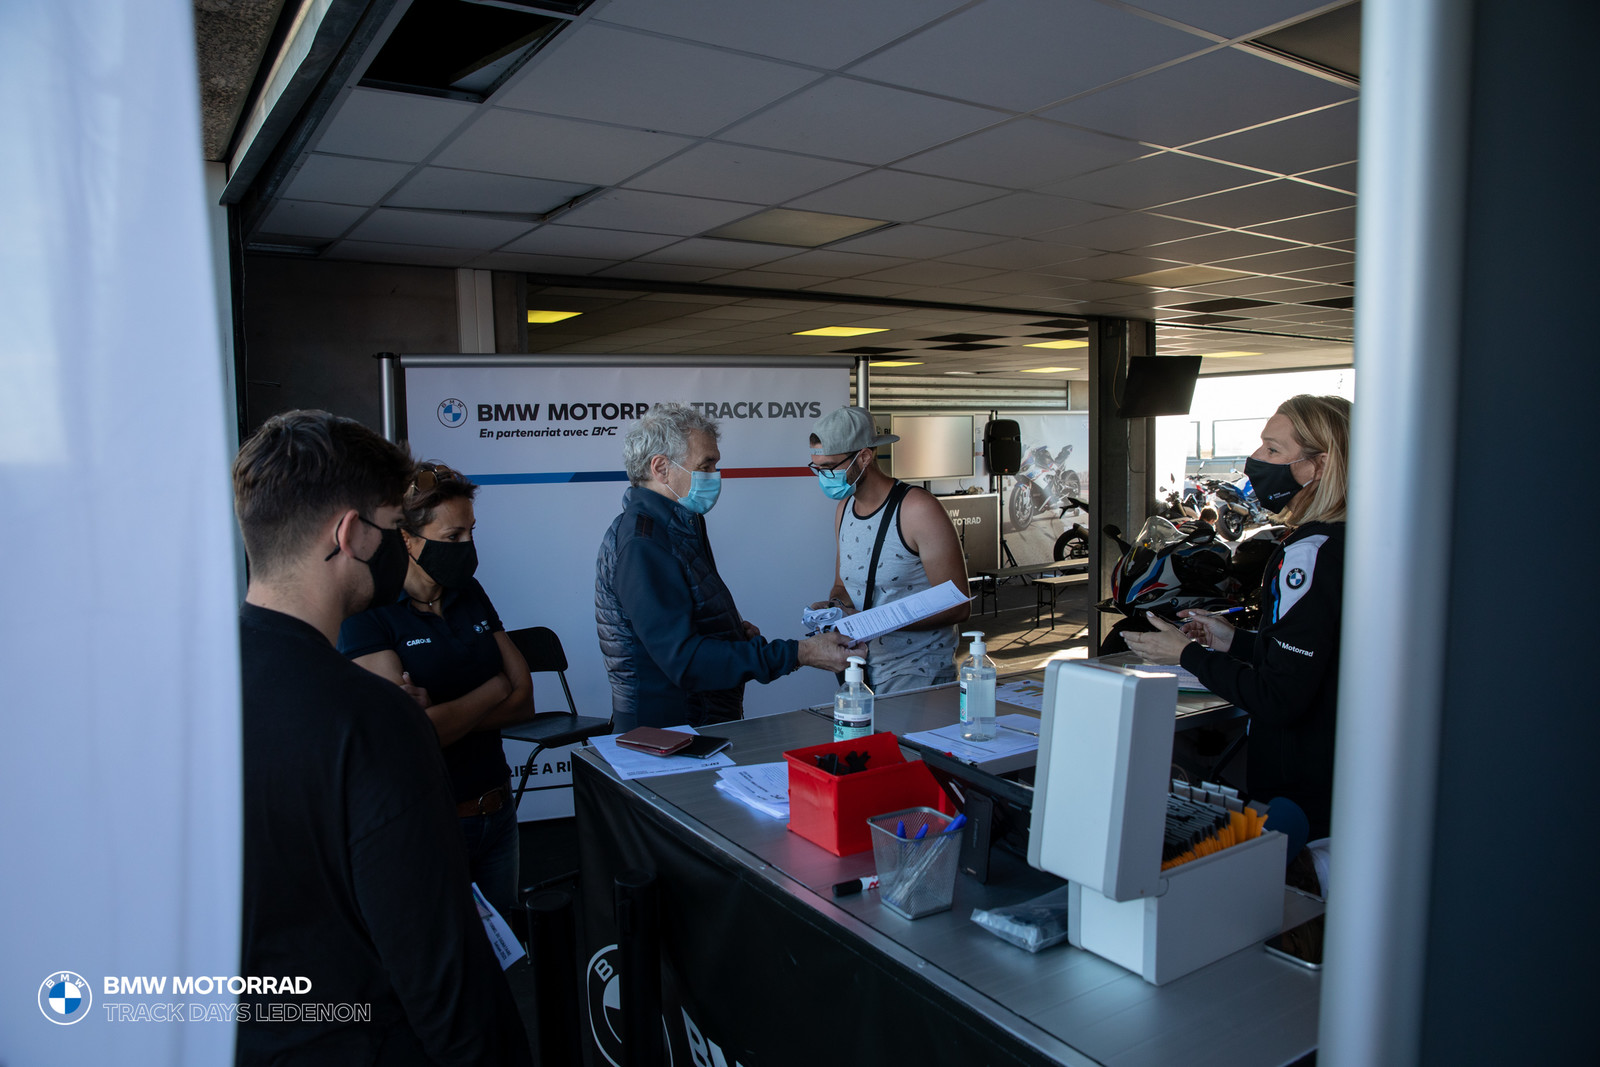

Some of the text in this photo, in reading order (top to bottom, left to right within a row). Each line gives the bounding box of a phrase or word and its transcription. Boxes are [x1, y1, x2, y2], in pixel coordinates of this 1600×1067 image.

[478, 401, 821, 421] BMW MOTORR TRACK DAYS
[479, 429, 494, 438] En
[496, 427, 561, 440] partenariat
[563, 429, 588, 438] avec
[953, 516, 982, 526] TORRAD
[1282, 642, 1315, 658] Motorrad
[510, 761, 571, 777] IFE A RI
